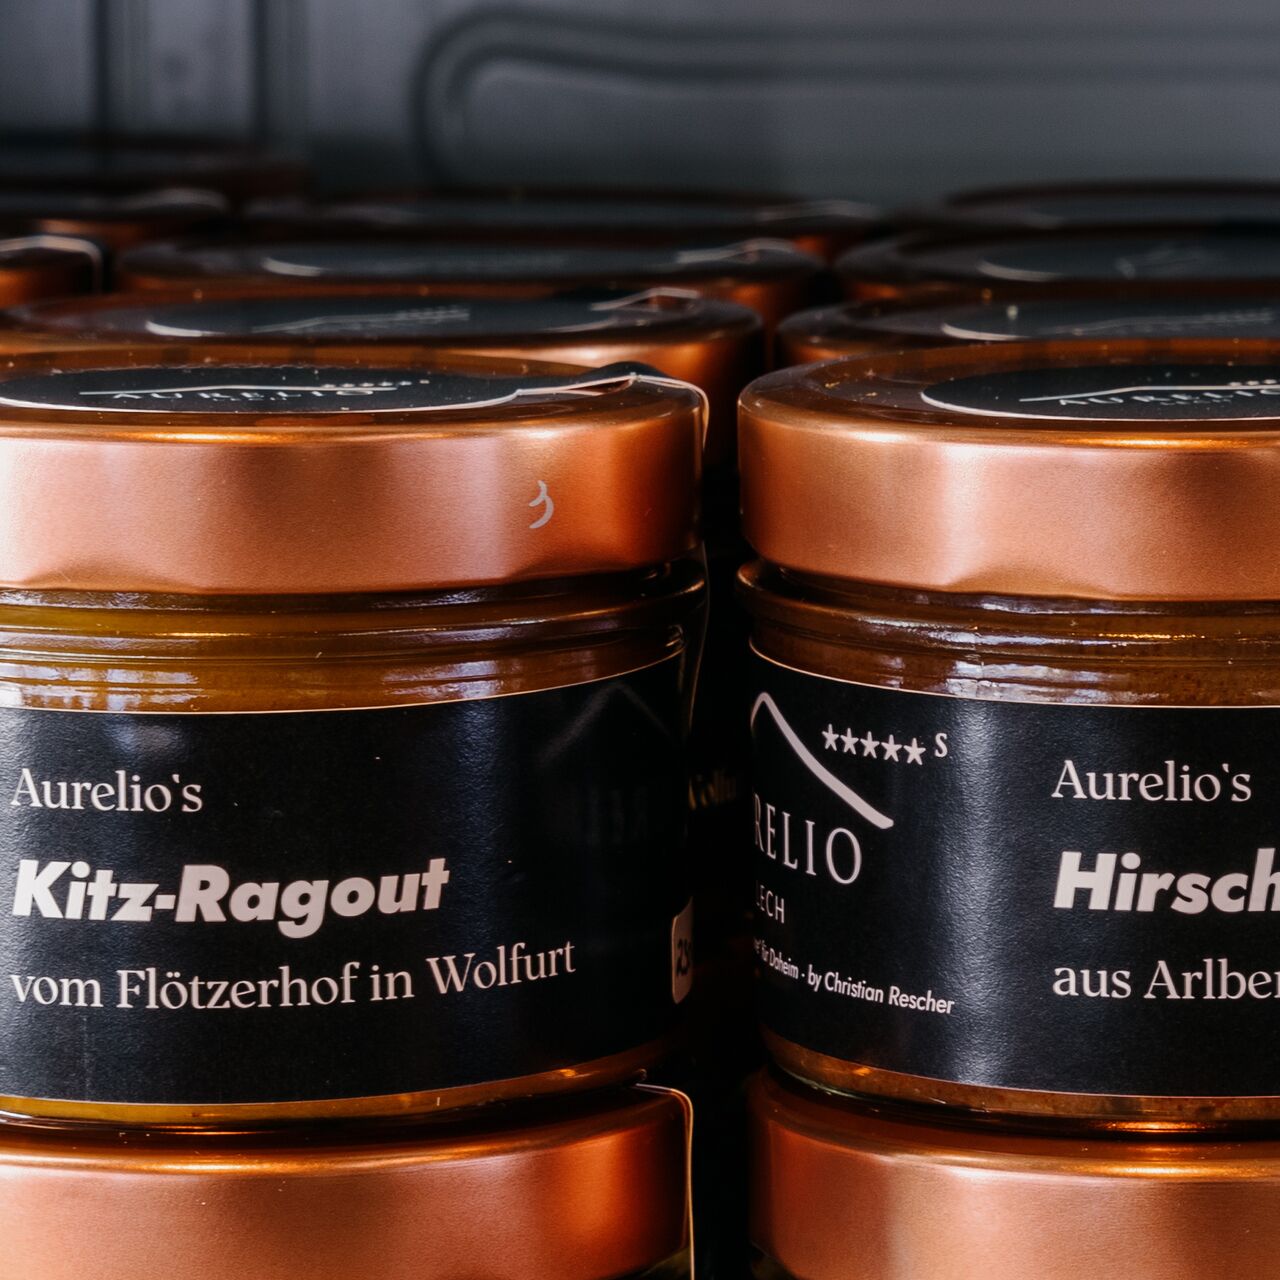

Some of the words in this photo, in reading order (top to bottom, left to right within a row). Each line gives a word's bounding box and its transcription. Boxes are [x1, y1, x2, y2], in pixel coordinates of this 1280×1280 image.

[12, 858, 450, 938] Kitz-Ragout
[11, 972, 102, 1008] vom
[116, 962, 360, 1009] Flötzerhof
[370, 965, 414, 1001] in
[426, 942, 575, 994] Wolfurt
[808, 964, 822, 991] by
[825, 972, 883, 1003] Christian
[889, 986, 955, 1014] Rescher
[1053, 968, 1131, 998] aus
